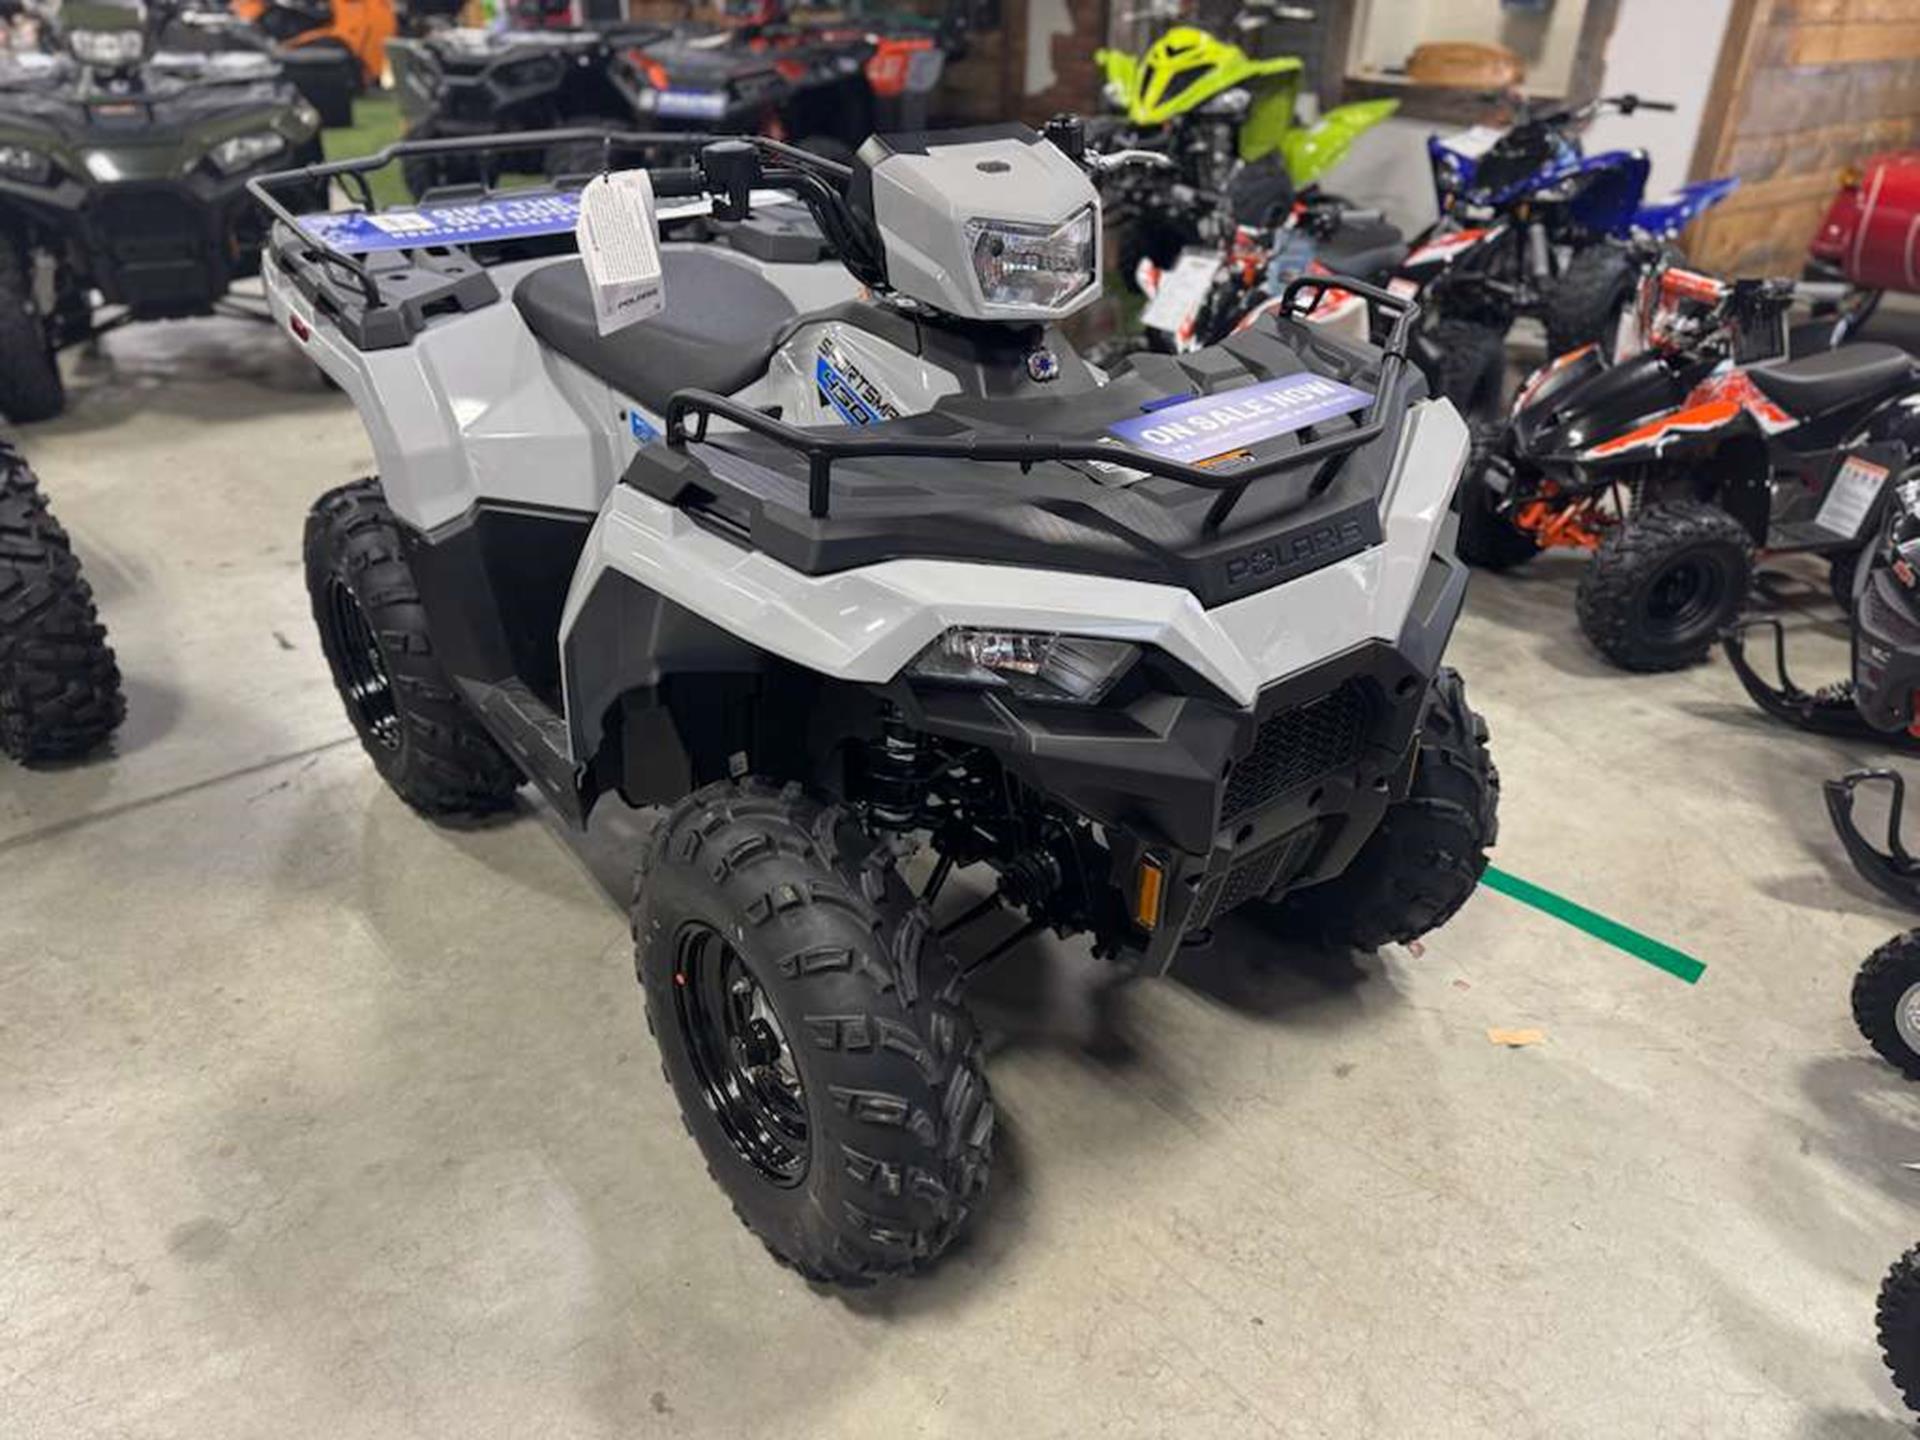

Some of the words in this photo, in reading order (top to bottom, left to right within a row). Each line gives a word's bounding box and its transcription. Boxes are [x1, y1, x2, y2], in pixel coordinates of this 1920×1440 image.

[1140, 421, 1197, 446] ON
[1187, 400, 1271, 433] SALE
[1271, 379, 1339, 413] NOW
[1226, 520, 1364, 586] POLARIS
